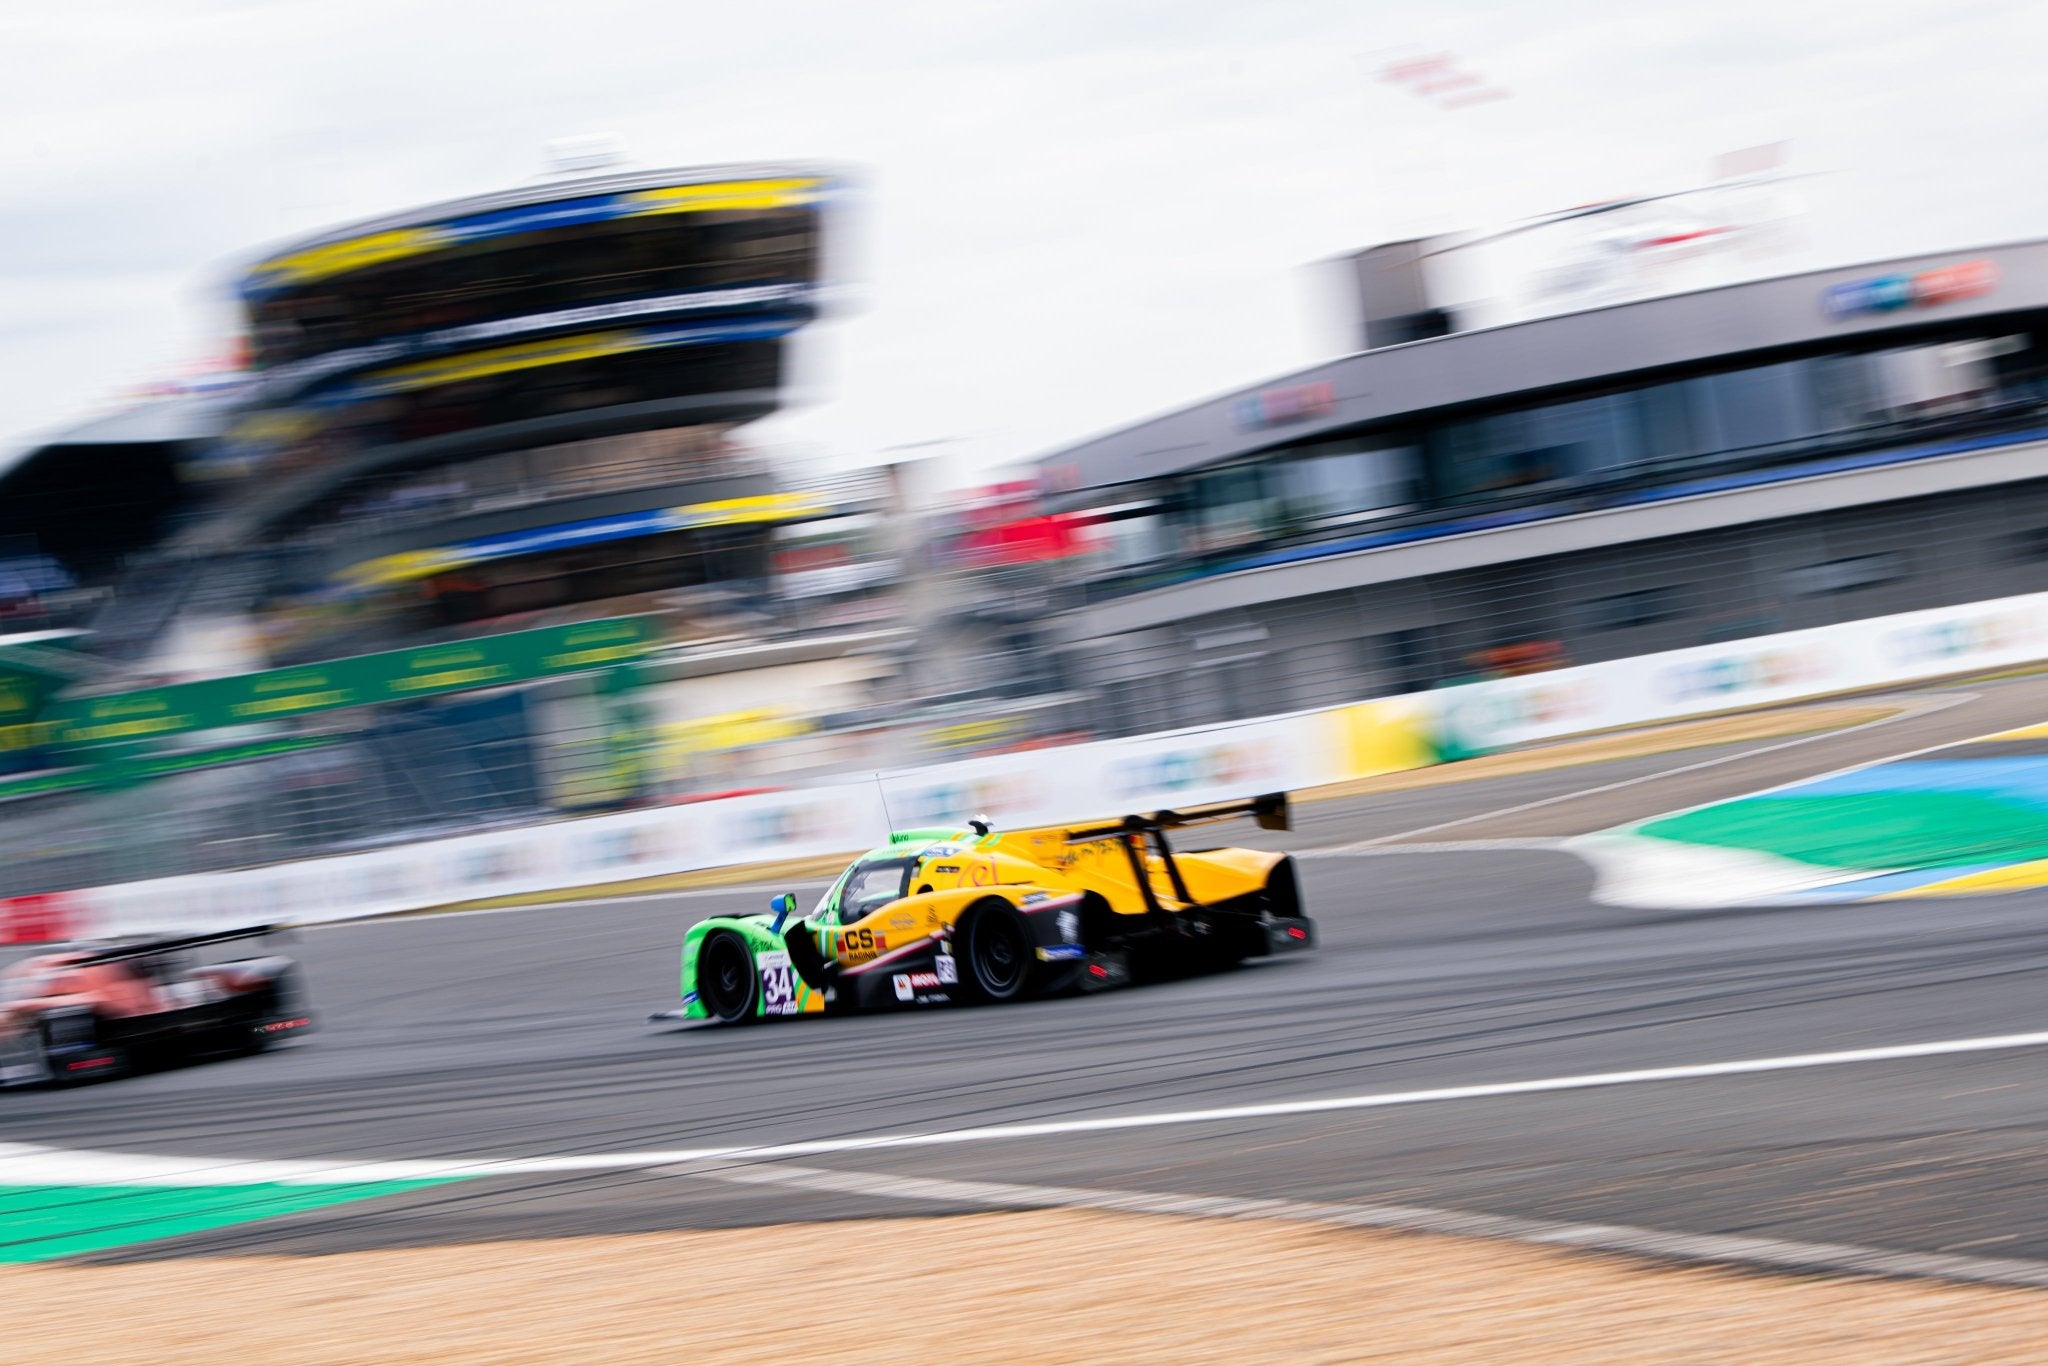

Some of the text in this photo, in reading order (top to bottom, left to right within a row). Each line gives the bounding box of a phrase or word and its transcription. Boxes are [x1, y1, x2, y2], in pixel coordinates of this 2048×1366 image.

[845, 928, 873, 950] CS
[848, 951, 878, 961] RACING
[763, 967, 792, 1004] 34
